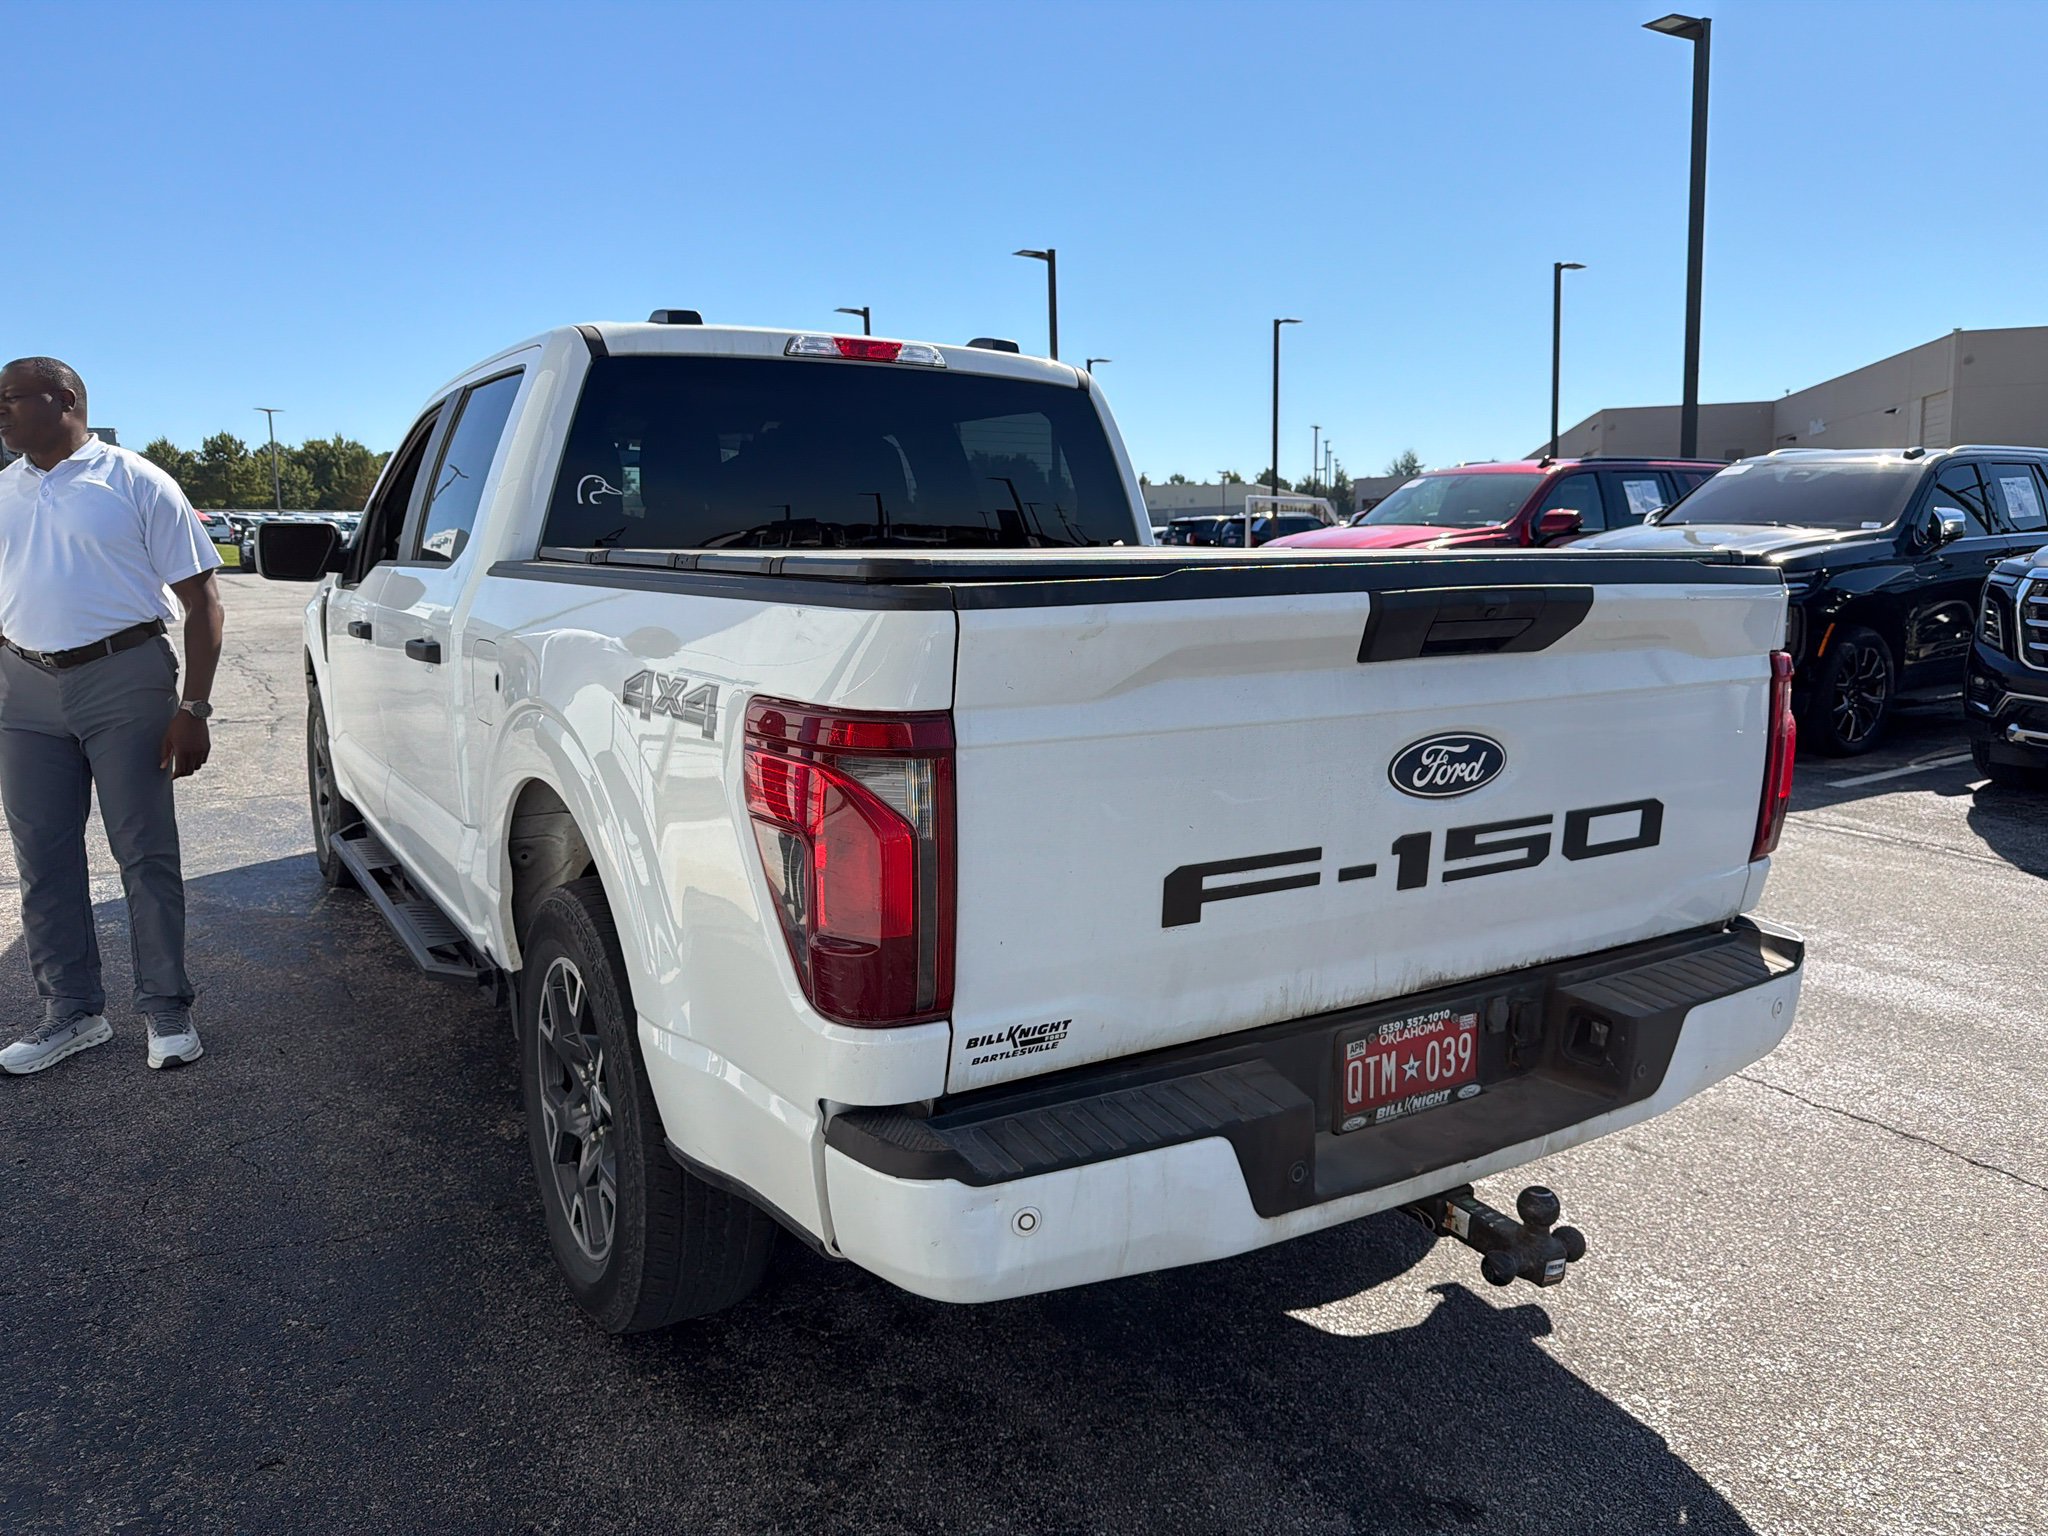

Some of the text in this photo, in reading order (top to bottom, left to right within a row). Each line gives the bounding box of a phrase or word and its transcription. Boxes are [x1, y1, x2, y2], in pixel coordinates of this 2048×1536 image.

[1412, 744, 1487, 788] Ford
[1161, 798, 1665, 928] F-150
[1379, 1021, 1403, 1034] (539)
[1406, 1009, 1451, 1029] 357-1010
[1379, 1020, 1445, 1046] OKLAHOMA
[1045, 1032, 1066, 1041] FORD
[1349, 1041, 1365, 1054] APR
[971, 1041, 1059, 1066] BARTLESVILLE
[1347, 1051, 1397, 1104] QTM
[1425, 1032, 1472, 1082] 039
